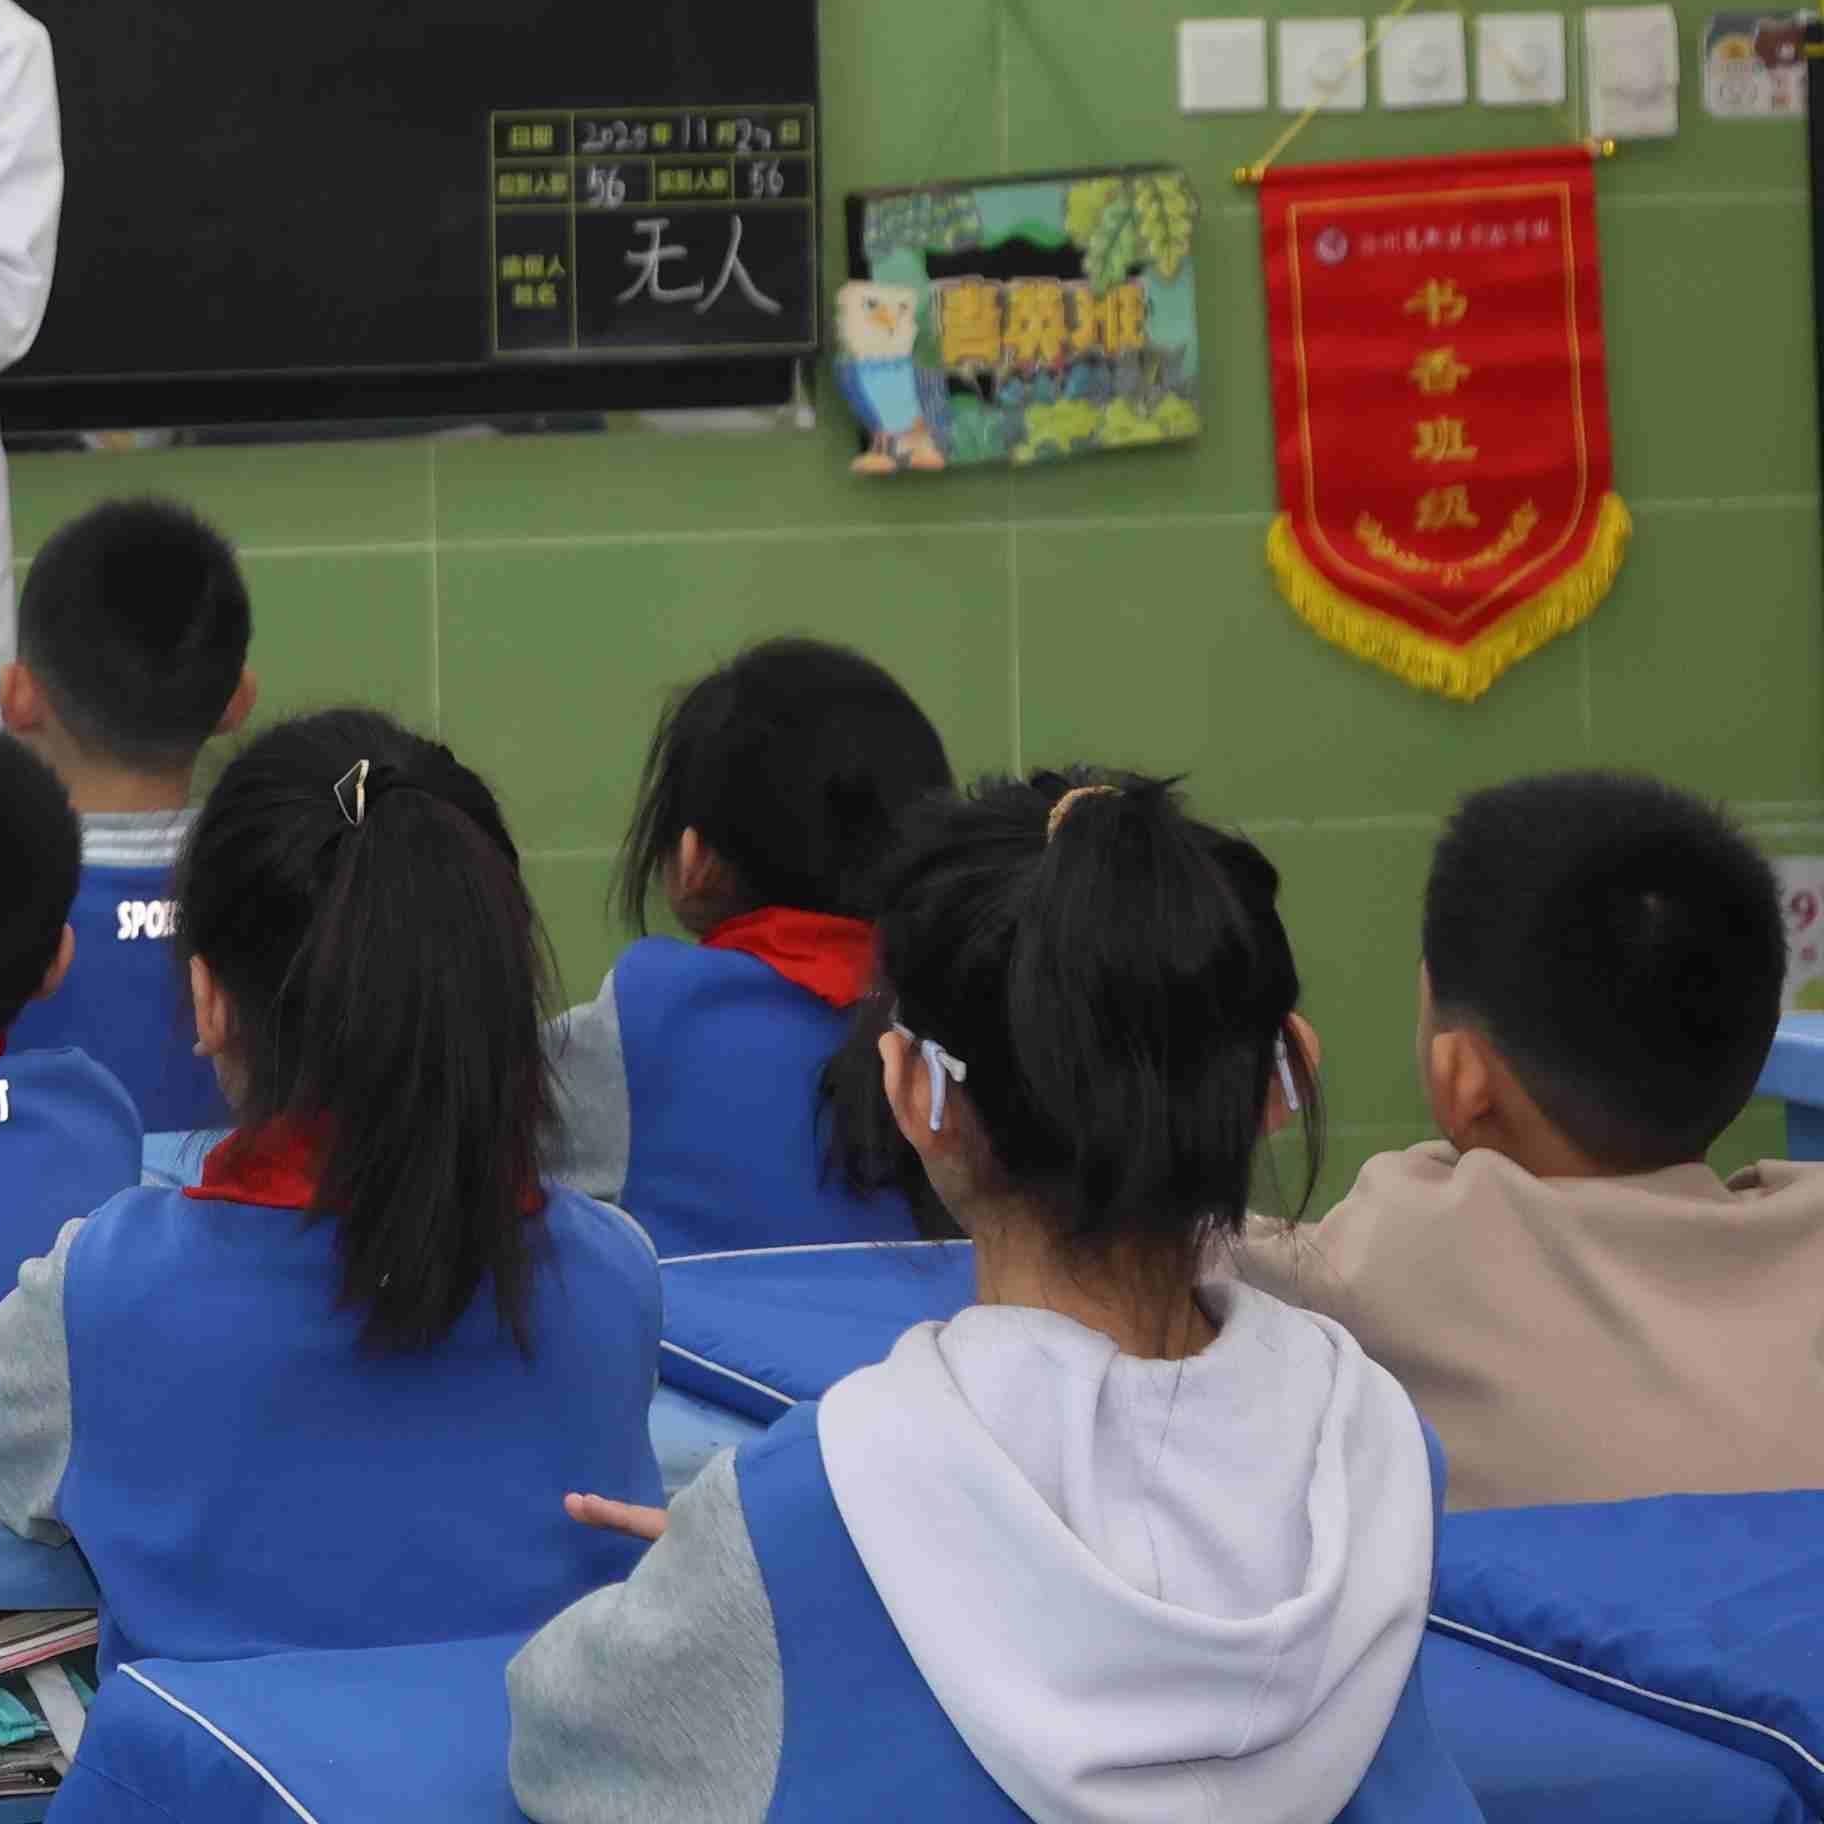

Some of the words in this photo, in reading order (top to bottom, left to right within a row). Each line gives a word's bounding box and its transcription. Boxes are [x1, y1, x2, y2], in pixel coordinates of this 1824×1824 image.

[586, 165, 627, 209] 56
[615, 214, 783, 315] 无人
[1402, 277, 1481, 531] 书香班级
